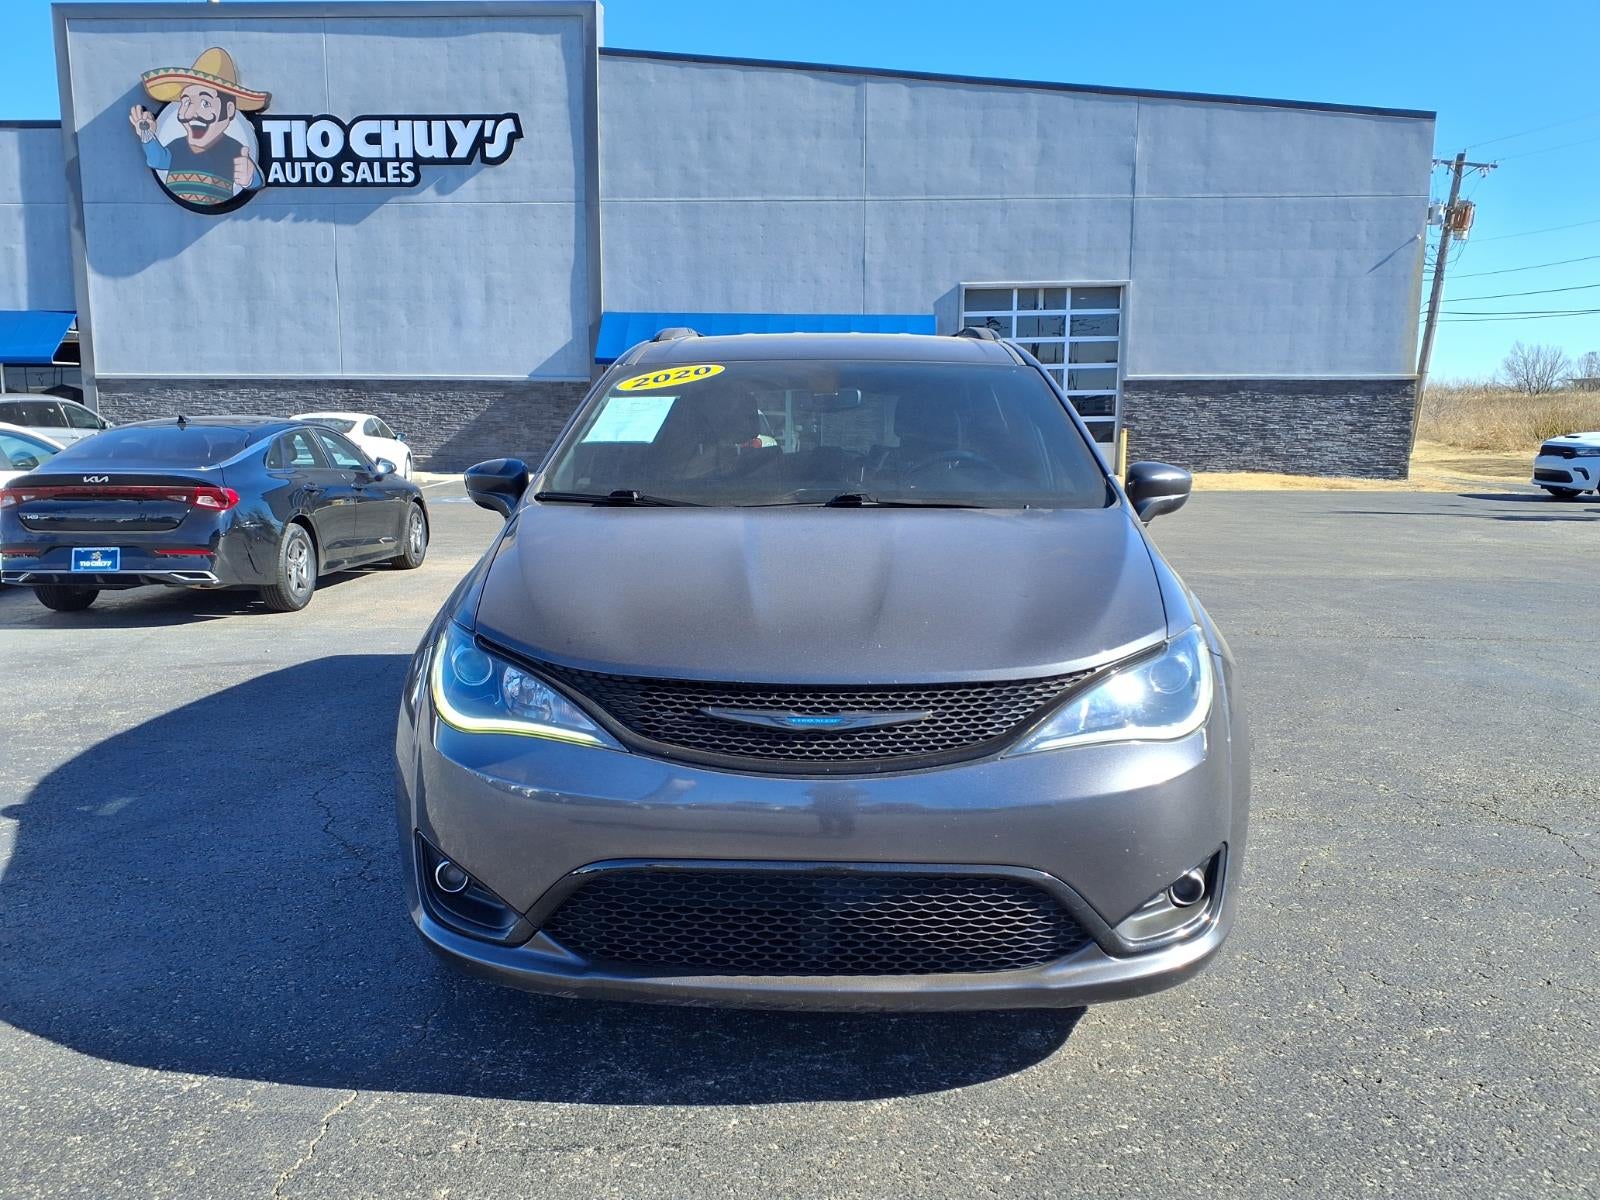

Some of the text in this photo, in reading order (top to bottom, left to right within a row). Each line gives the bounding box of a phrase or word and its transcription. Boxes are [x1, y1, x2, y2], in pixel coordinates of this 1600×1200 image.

[262, 118, 517, 158] TIO CHUY'S
[267, 161, 415, 183] AUTO SALES
[631, 366, 712, 388] 2020
[82, 475, 109, 483] KIA
